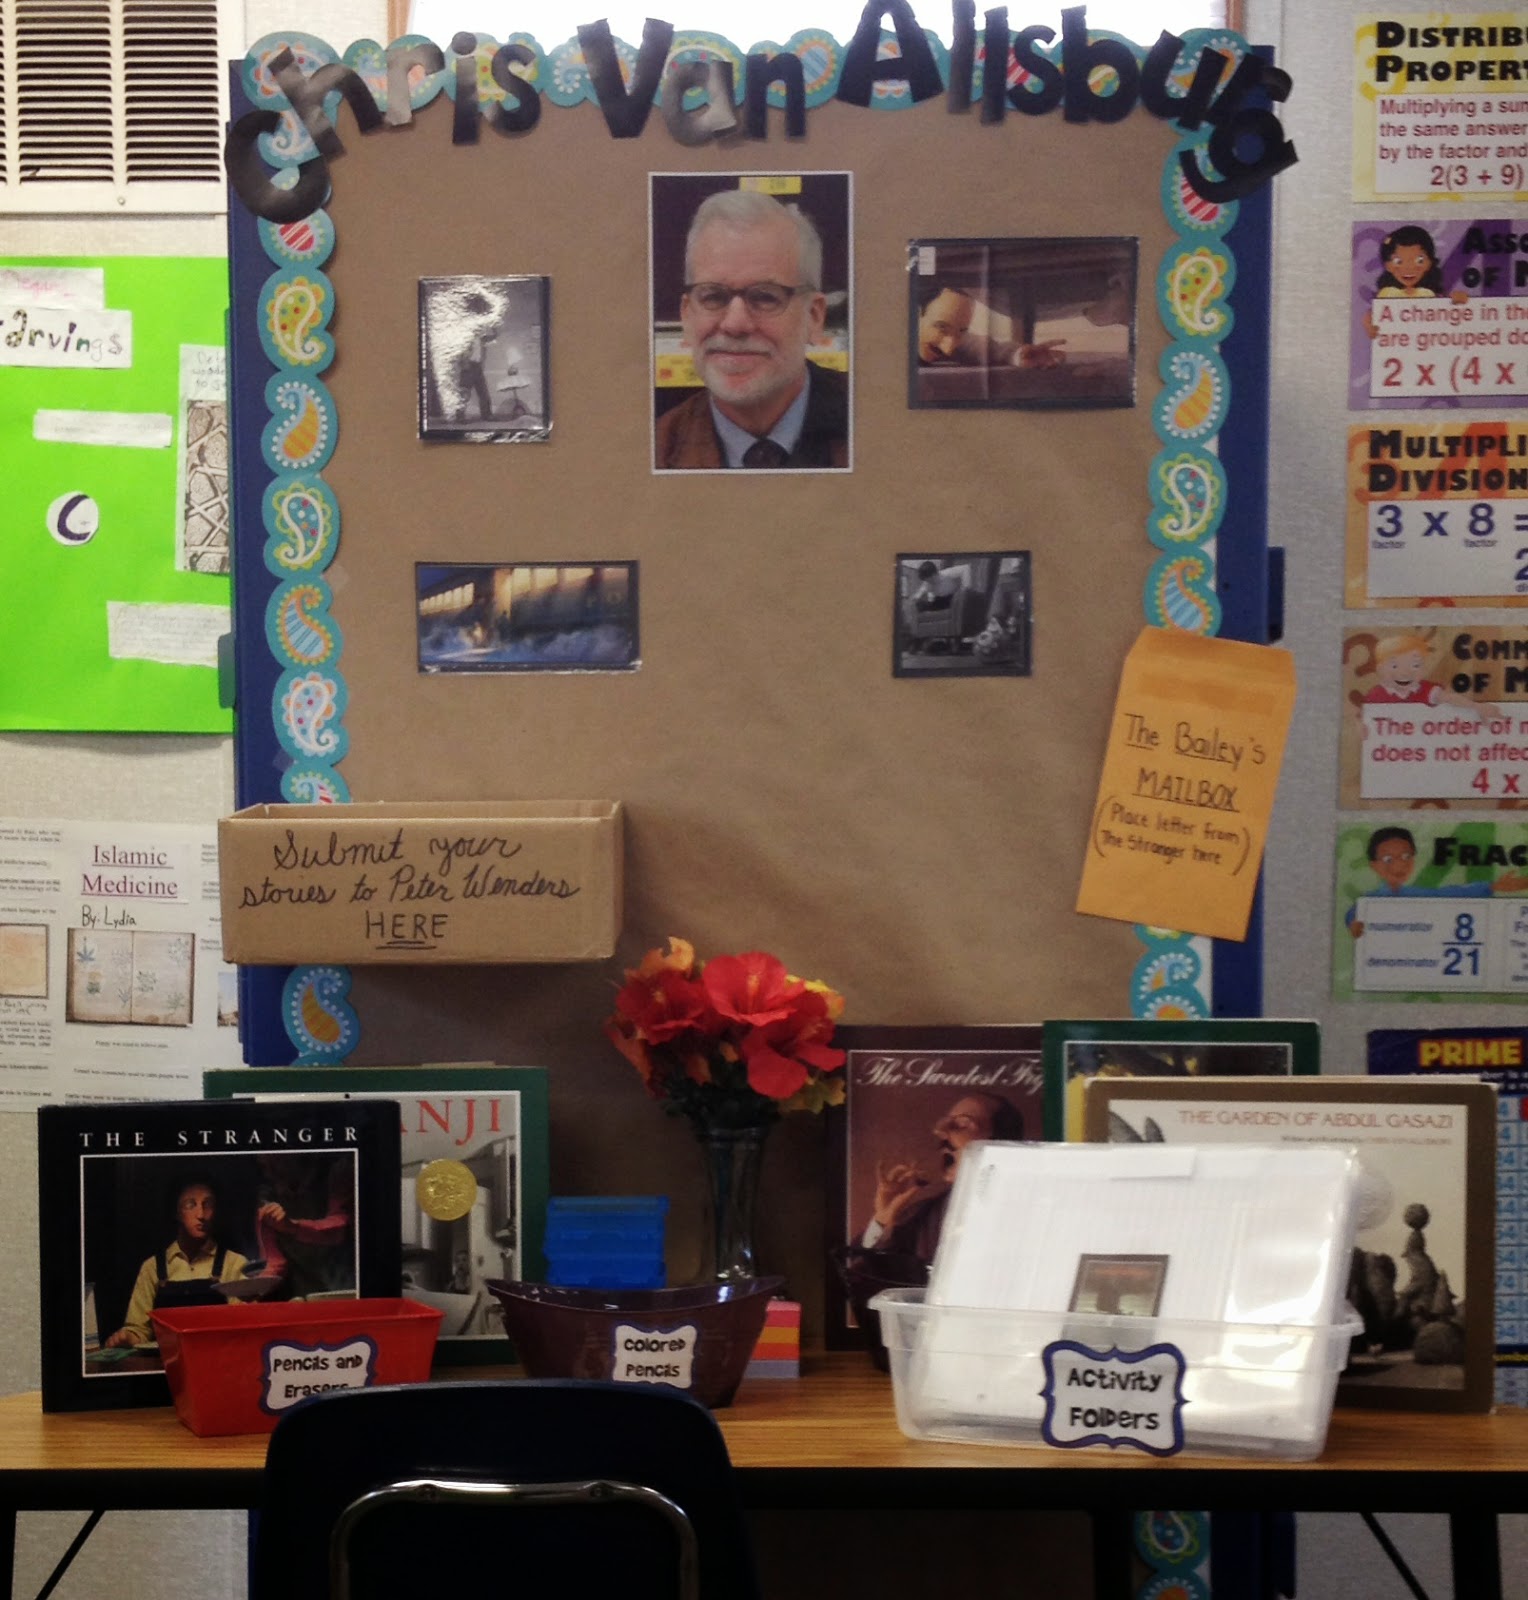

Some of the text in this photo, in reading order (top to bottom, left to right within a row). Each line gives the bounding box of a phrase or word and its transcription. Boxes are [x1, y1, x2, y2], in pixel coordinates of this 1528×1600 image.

[1377, 21, 1528, 48] DISTRIB
[225, 0, 1298, 223] Chris Van Allsburg
[1381, 98, 1476, 118] Multiplying
[1482, 101, 1493, 114] a
[1380, 123, 1407, 137] the
[1412, 124, 1459, 137] same
[1380, 143, 1528, 163] by the factor and
[1430, 164, 1468, 191] 2(3
[1501, 163, 1525, 191] 9)
[1379, 305, 1394, 322] A
[1400, 305, 1473, 326] change
[1480, 304, 1499, 321] in
[0, 309, 122, 362] arvings
[1379, 332, 1410, 347] are
[1417, 327, 1501, 351] grouped
[1383, 358, 1403, 387] 2
[1450, 355, 1482, 393] (4
[1376, 504, 1404, 538] 3
[1422, 511, 1449, 537] x
[1468, 502, 1495, 536] 8
[1373, 717, 1414, 735] The
[1422, 717, 1482, 735] order
[1490, 716, 1512, 735] of
[1124, 713, 1266, 770] The Bailey's
[1372, 744, 1426, 762] does
[1434, 743, 1471, 761] not
[1137, 767, 1239, 809] MAILBOX
[1472, 768, 1490, 794] 4
[93, 845, 168, 867] Islamic
[274, 829, 522, 875] Submit your
[82, 874, 178, 896] Medicine
[239, 878, 337, 909] stories
[349, 874, 378, 902] to
[389, 865, 454, 902] Peter
[463, 863, 581, 899] Wenders
[104, 906, 137, 928] Lydia
[365, 910, 449, 939] HERE
[1455, 913, 1474, 941] 8
[1443, 948, 1480, 976] 21
[1420, 1038, 1522, 1067] PRIME
[857, 1056, 902, 1085] The
[401, 1099, 501, 1145] NJI
[1178, 1110, 1453, 1129] THE GARDEN OF ABDUL GASAZI
[80, 1126, 358, 1147] THE STRANGER
